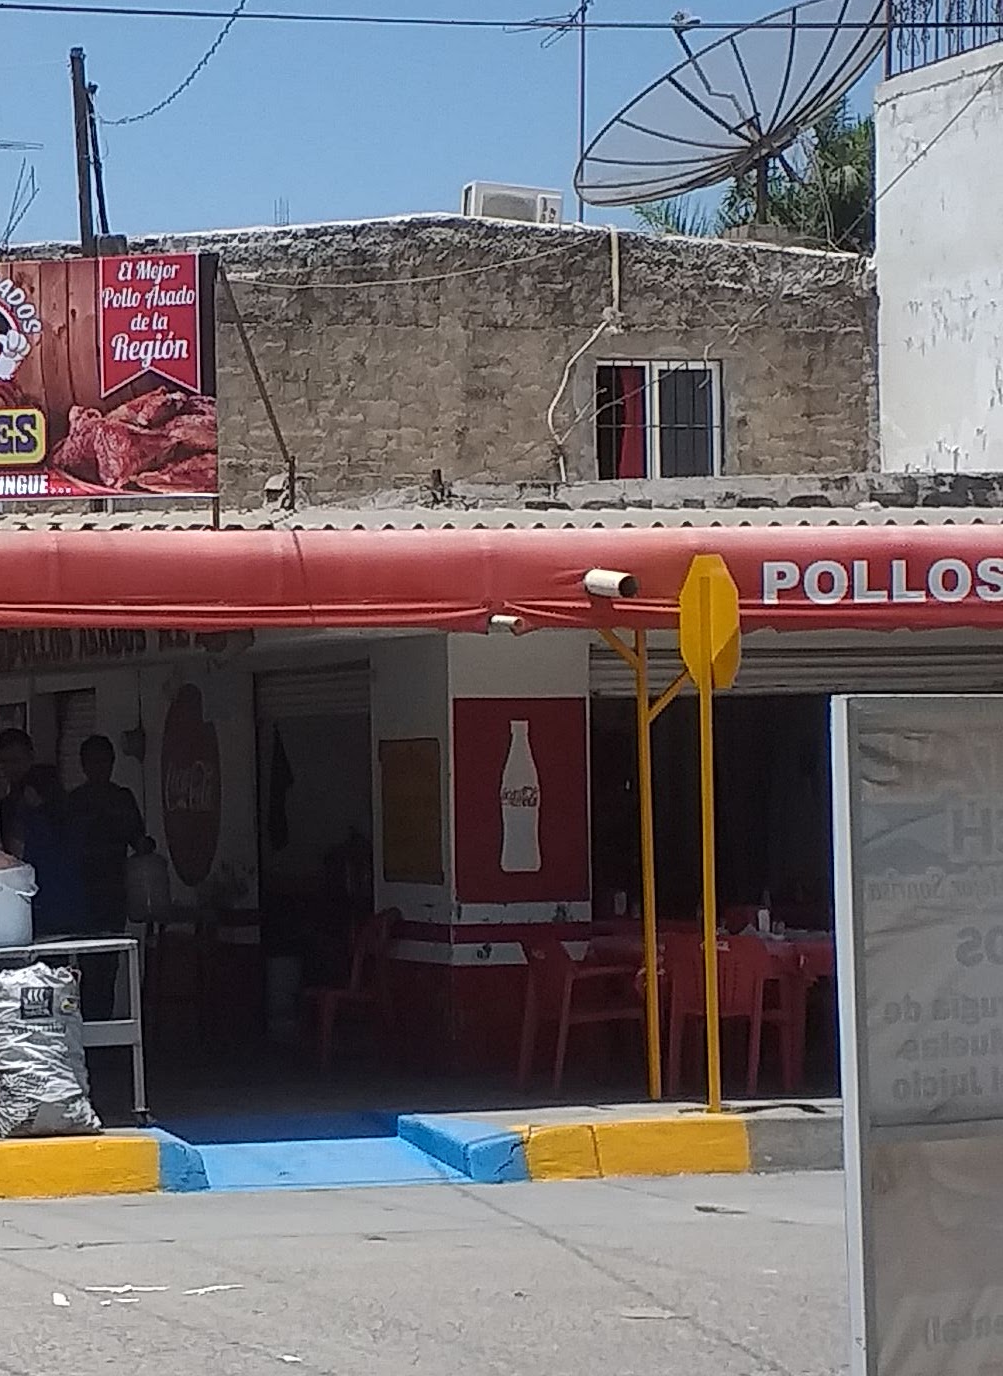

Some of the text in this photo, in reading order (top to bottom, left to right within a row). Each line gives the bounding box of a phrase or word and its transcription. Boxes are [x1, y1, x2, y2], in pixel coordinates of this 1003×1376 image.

[117, 259, 181, 285] El Mejor
[102, 284, 195, 310] Pollo Asado
[130, 311, 169, 331] de la
[111, 330, 189, 369] Región
[761, 558, 1003, 605] POLLOS
